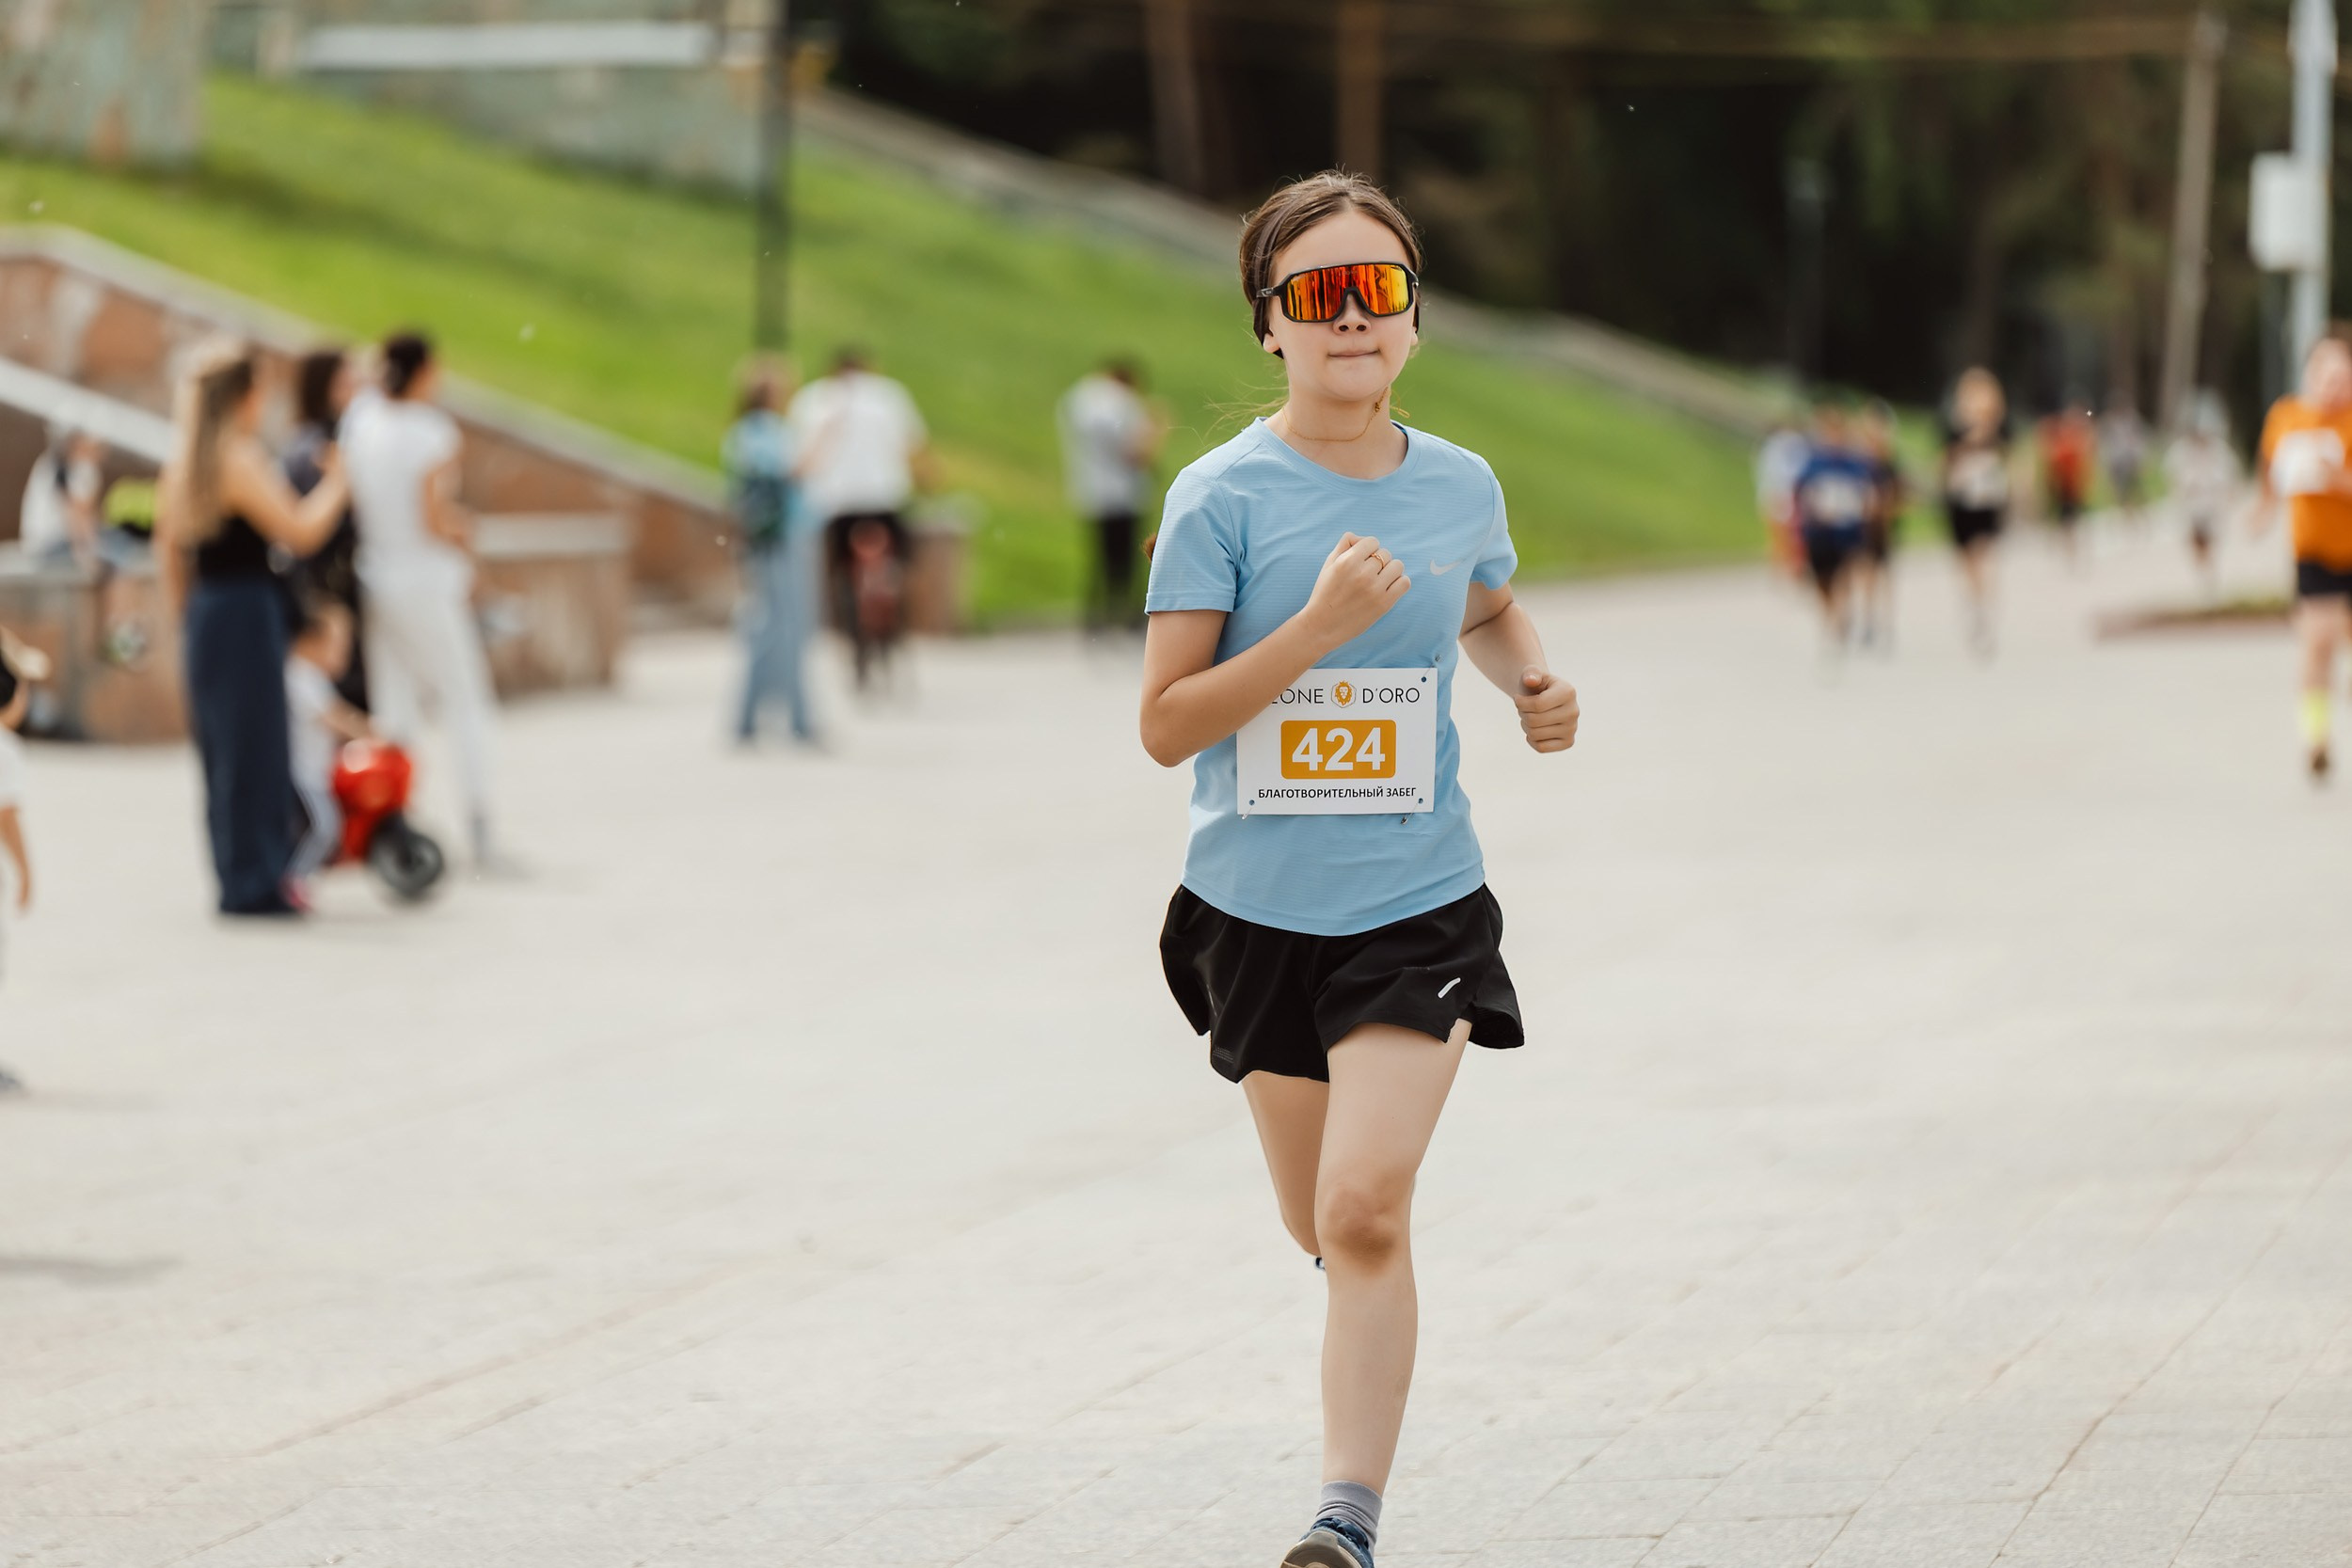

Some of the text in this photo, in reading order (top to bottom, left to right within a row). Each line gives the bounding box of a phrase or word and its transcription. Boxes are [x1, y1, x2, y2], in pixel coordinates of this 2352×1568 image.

[1271, 688, 1421, 705] ONE D'ORO
[1292, 727, 1386, 771] 424
[1258, 786, 1417, 799] БЛАГОТВОРИТЕЛЬНЫЙ ЗАБЕГ
